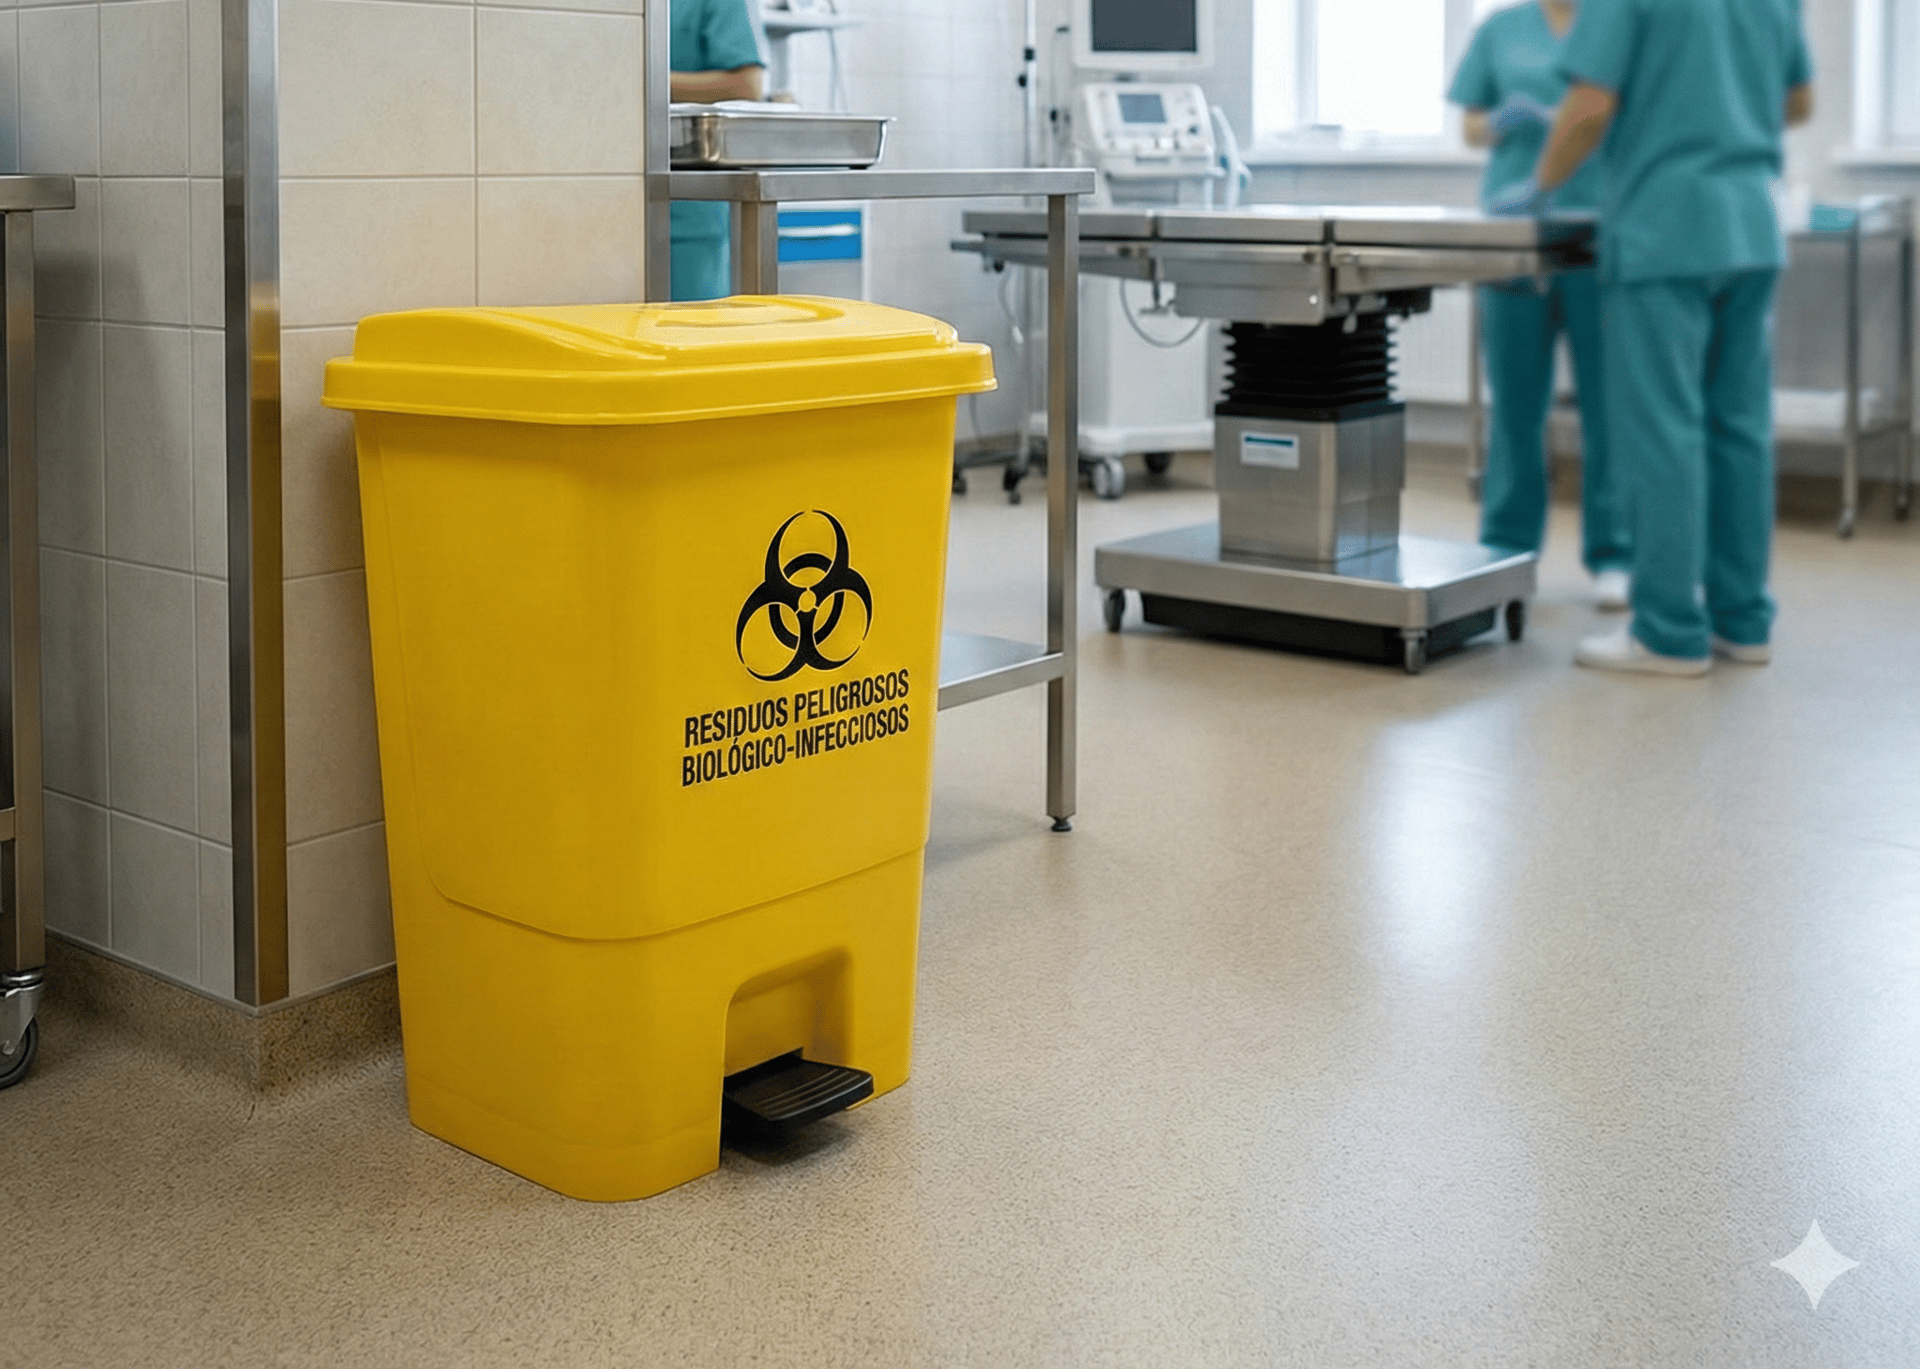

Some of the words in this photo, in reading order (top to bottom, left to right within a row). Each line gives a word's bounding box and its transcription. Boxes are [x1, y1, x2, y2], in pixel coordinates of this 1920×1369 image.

[682, 703, 909, 787] BIOLÓGICO-INFECCIOSOS
[684, 696, 788, 748] RESIDUOS
[794, 668, 909, 723] PELIGROSOS
